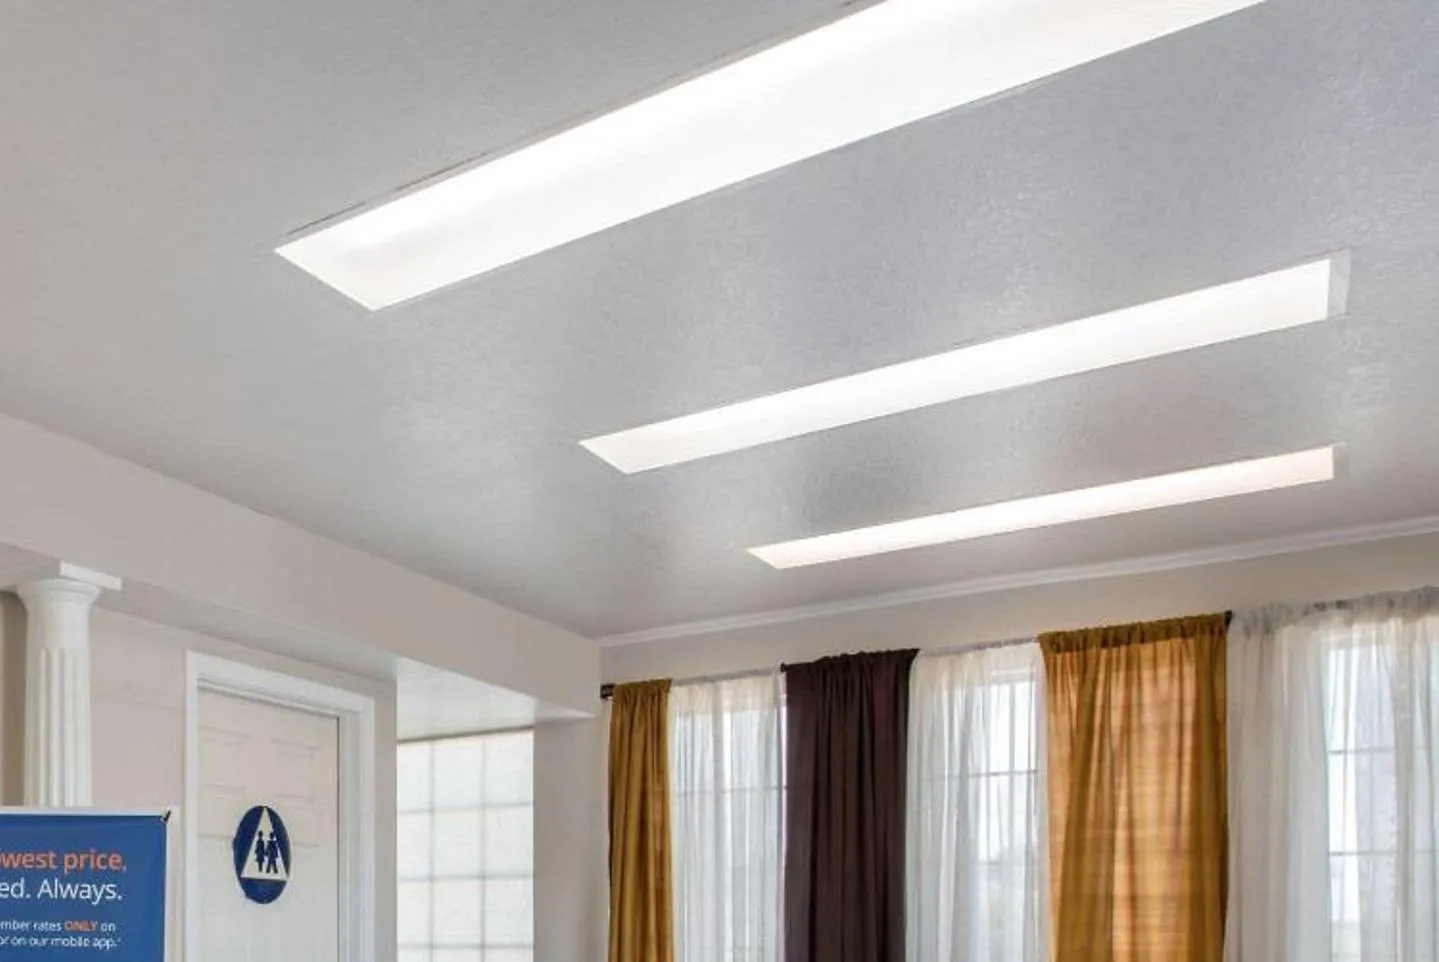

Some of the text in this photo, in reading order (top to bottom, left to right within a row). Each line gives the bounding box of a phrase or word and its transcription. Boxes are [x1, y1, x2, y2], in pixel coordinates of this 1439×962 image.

[37, 880, 122, 905] Always.
[33, 920, 62, 931] rates
[101, 922, 116, 932] on
[11, 935, 27, 946] on
[29, 936, 47, 946] our
[50, 936, 90, 947] mobile
